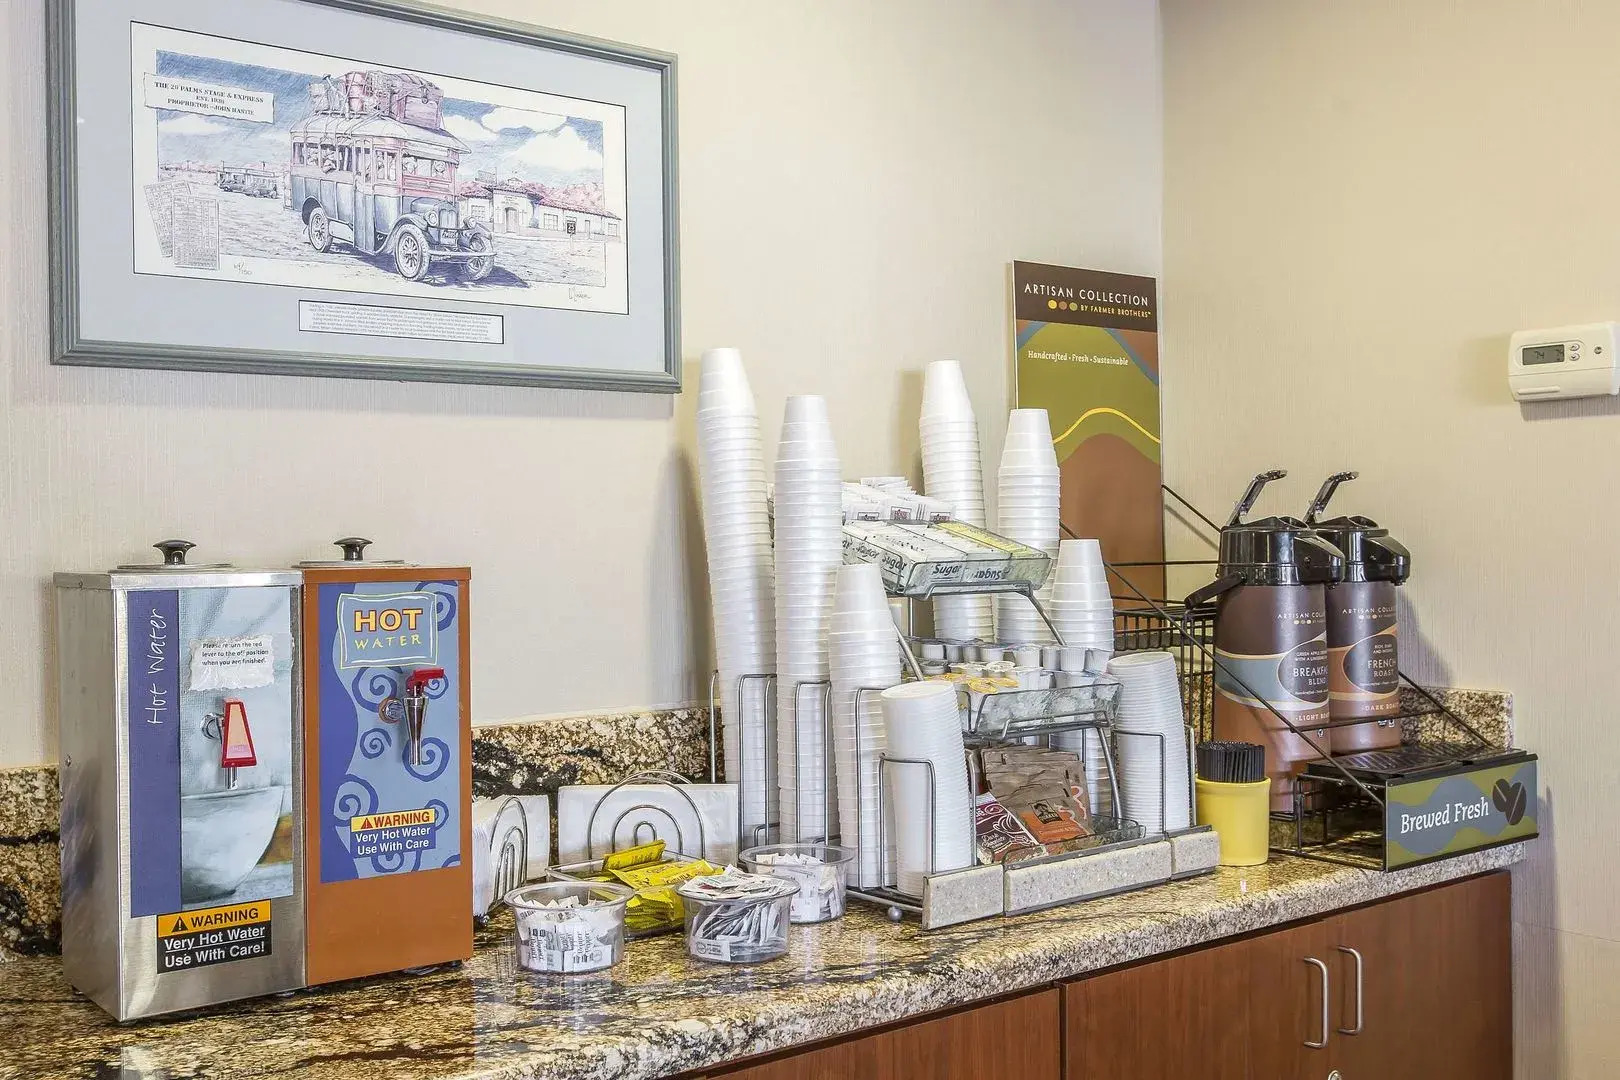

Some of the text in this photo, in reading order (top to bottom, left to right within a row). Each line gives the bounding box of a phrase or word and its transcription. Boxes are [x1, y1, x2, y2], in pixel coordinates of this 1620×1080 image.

[154, 81, 168, 89] THE
[180, 85, 203, 94] PALMS
[204, 89, 225, 99] STAGE
[233, 94, 264, 103] EXPRESS
[1024, 283, 1148, 306] ARTISAN COLLECTION
[1091, 305, 1114, 315] FARMER
[1028, 350, 1129, 366] Handcrafted Fresh Sustainable
[932, 563, 962, 576] Sugar
[354, 608, 423, 632] HOT
[1277, 611, 1309, 619] ARTISAN
[354, 634, 421, 649] WATER
[246, 649, 269, 657] position
[145, 608, 167, 724] Hot Water
[1367, 658, 1396, 669] FRENCH
[1299, 713, 1319, 721] LIGHT
[374, 812, 430, 828] WARNING
[1400, 797, 1489, 833] Brewed Fresh
[356, 826, 431, 844] Very Hot Water
[357, 839, 429, 855] Use With Care
[191, 907, 259, 928] WARNING
[164, 925, 265, 951] Very Hot Water
[165, 941, 265, 968] Use With Care!
